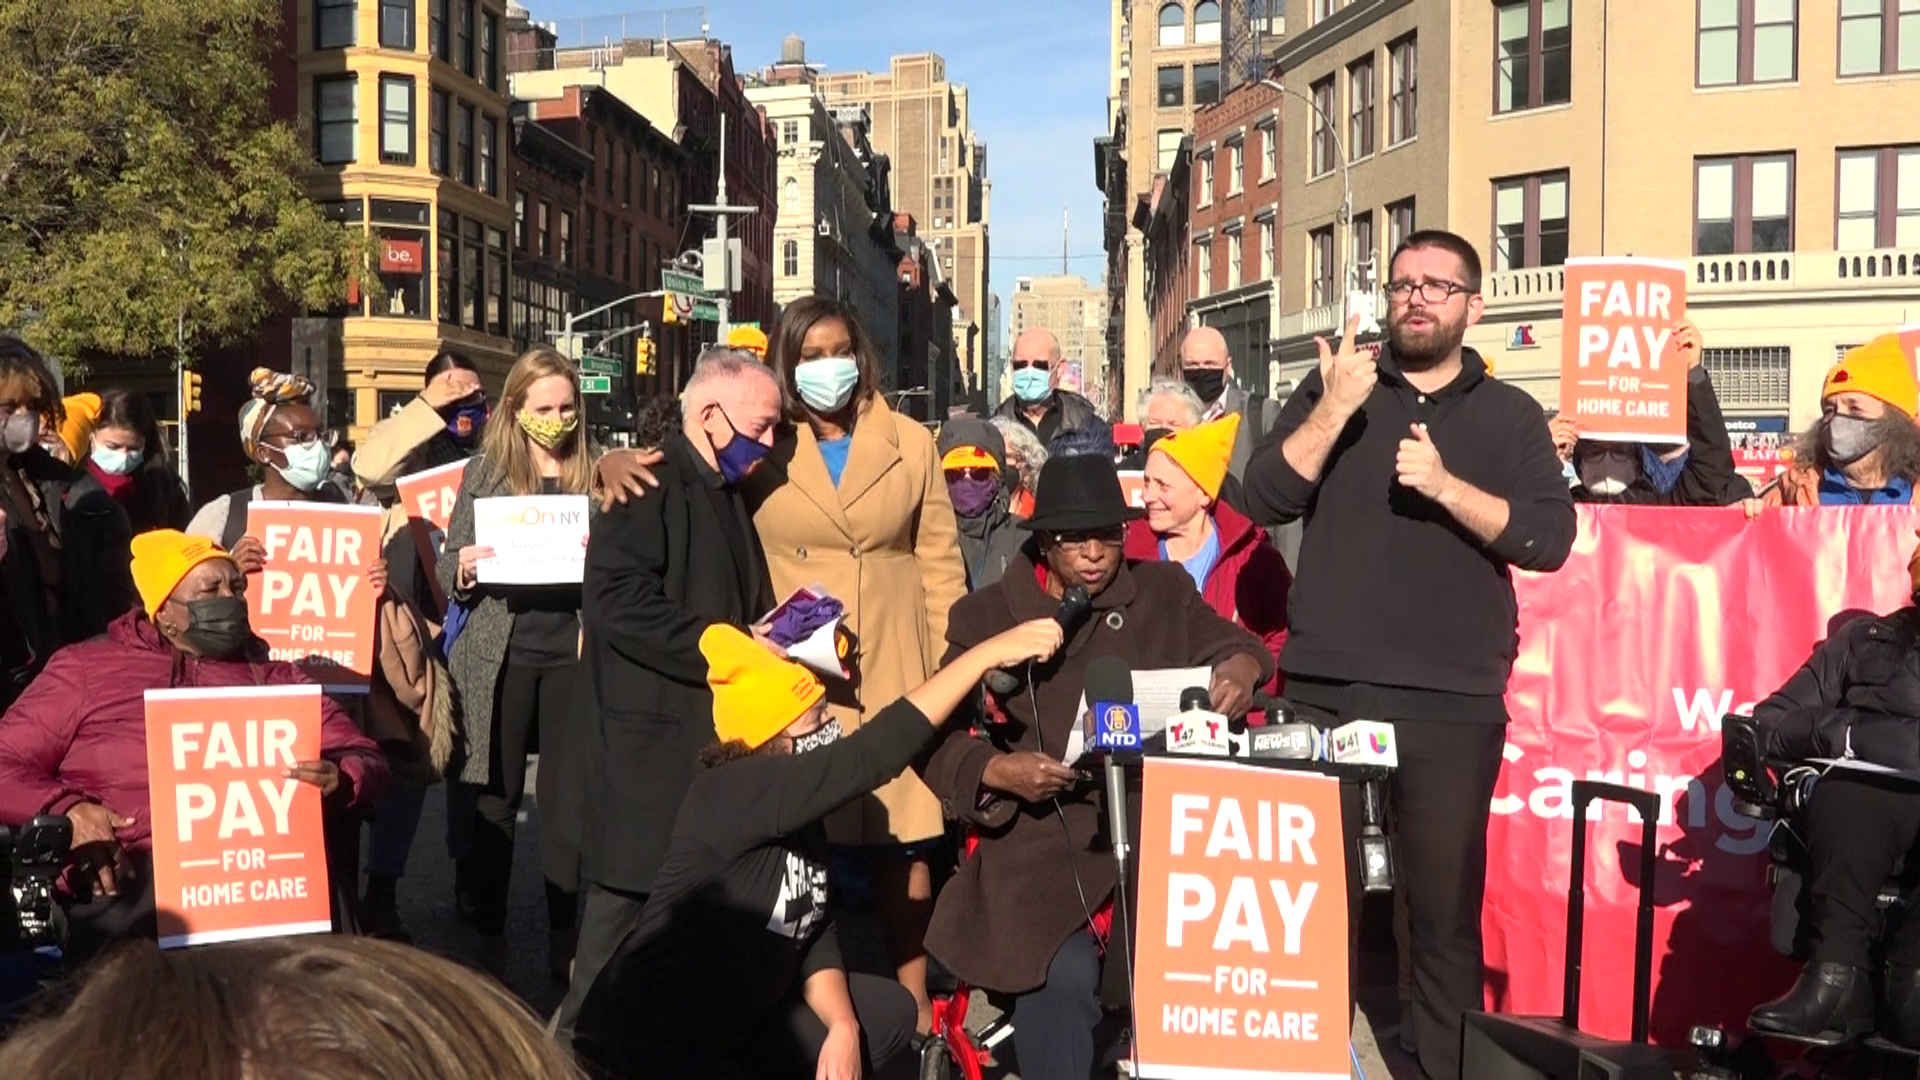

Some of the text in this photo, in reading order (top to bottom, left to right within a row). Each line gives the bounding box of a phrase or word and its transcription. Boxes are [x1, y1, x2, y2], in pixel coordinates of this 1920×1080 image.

[388, 244, 413, 262] be.
[665, 275, 687, 291] Union
[1580, 280, 1672, 321] FAIR
[1578, 325, 1672, 371] PAY
[1608, 376, 1640, 393] FOR
[1577, 398, 1670, 417] HOME CARE
[417, 486, 458, 519] FA
[560, 511, 581, 525] NY
[264, 525, 363, 565] FAIR
[260, 570, 360, 618] PAY
[290, 624, 325, 641] FOR
[269, 648, 355, 667] OME CARE
[171, 719, 298, 771] FAIR
[1102, 733, 1137, 746] NTD
[1182, 728, 1194, 741] 47
[1254, 735, 1290, 751] NEWS
[1347, 731, 1359, 747] 41
[175, 779, 299, 843] PAY
[1169, 793, 1318, 865] FAIR
[222, 848, 266, 872] FOR
[181, 876, 308, 909] HOME CARE
[1165, 872, 1319, 955] PAY
[1214, 965, 1267, 996] FOR
[1162, 1004, 1319, 1041] HOME CARE
